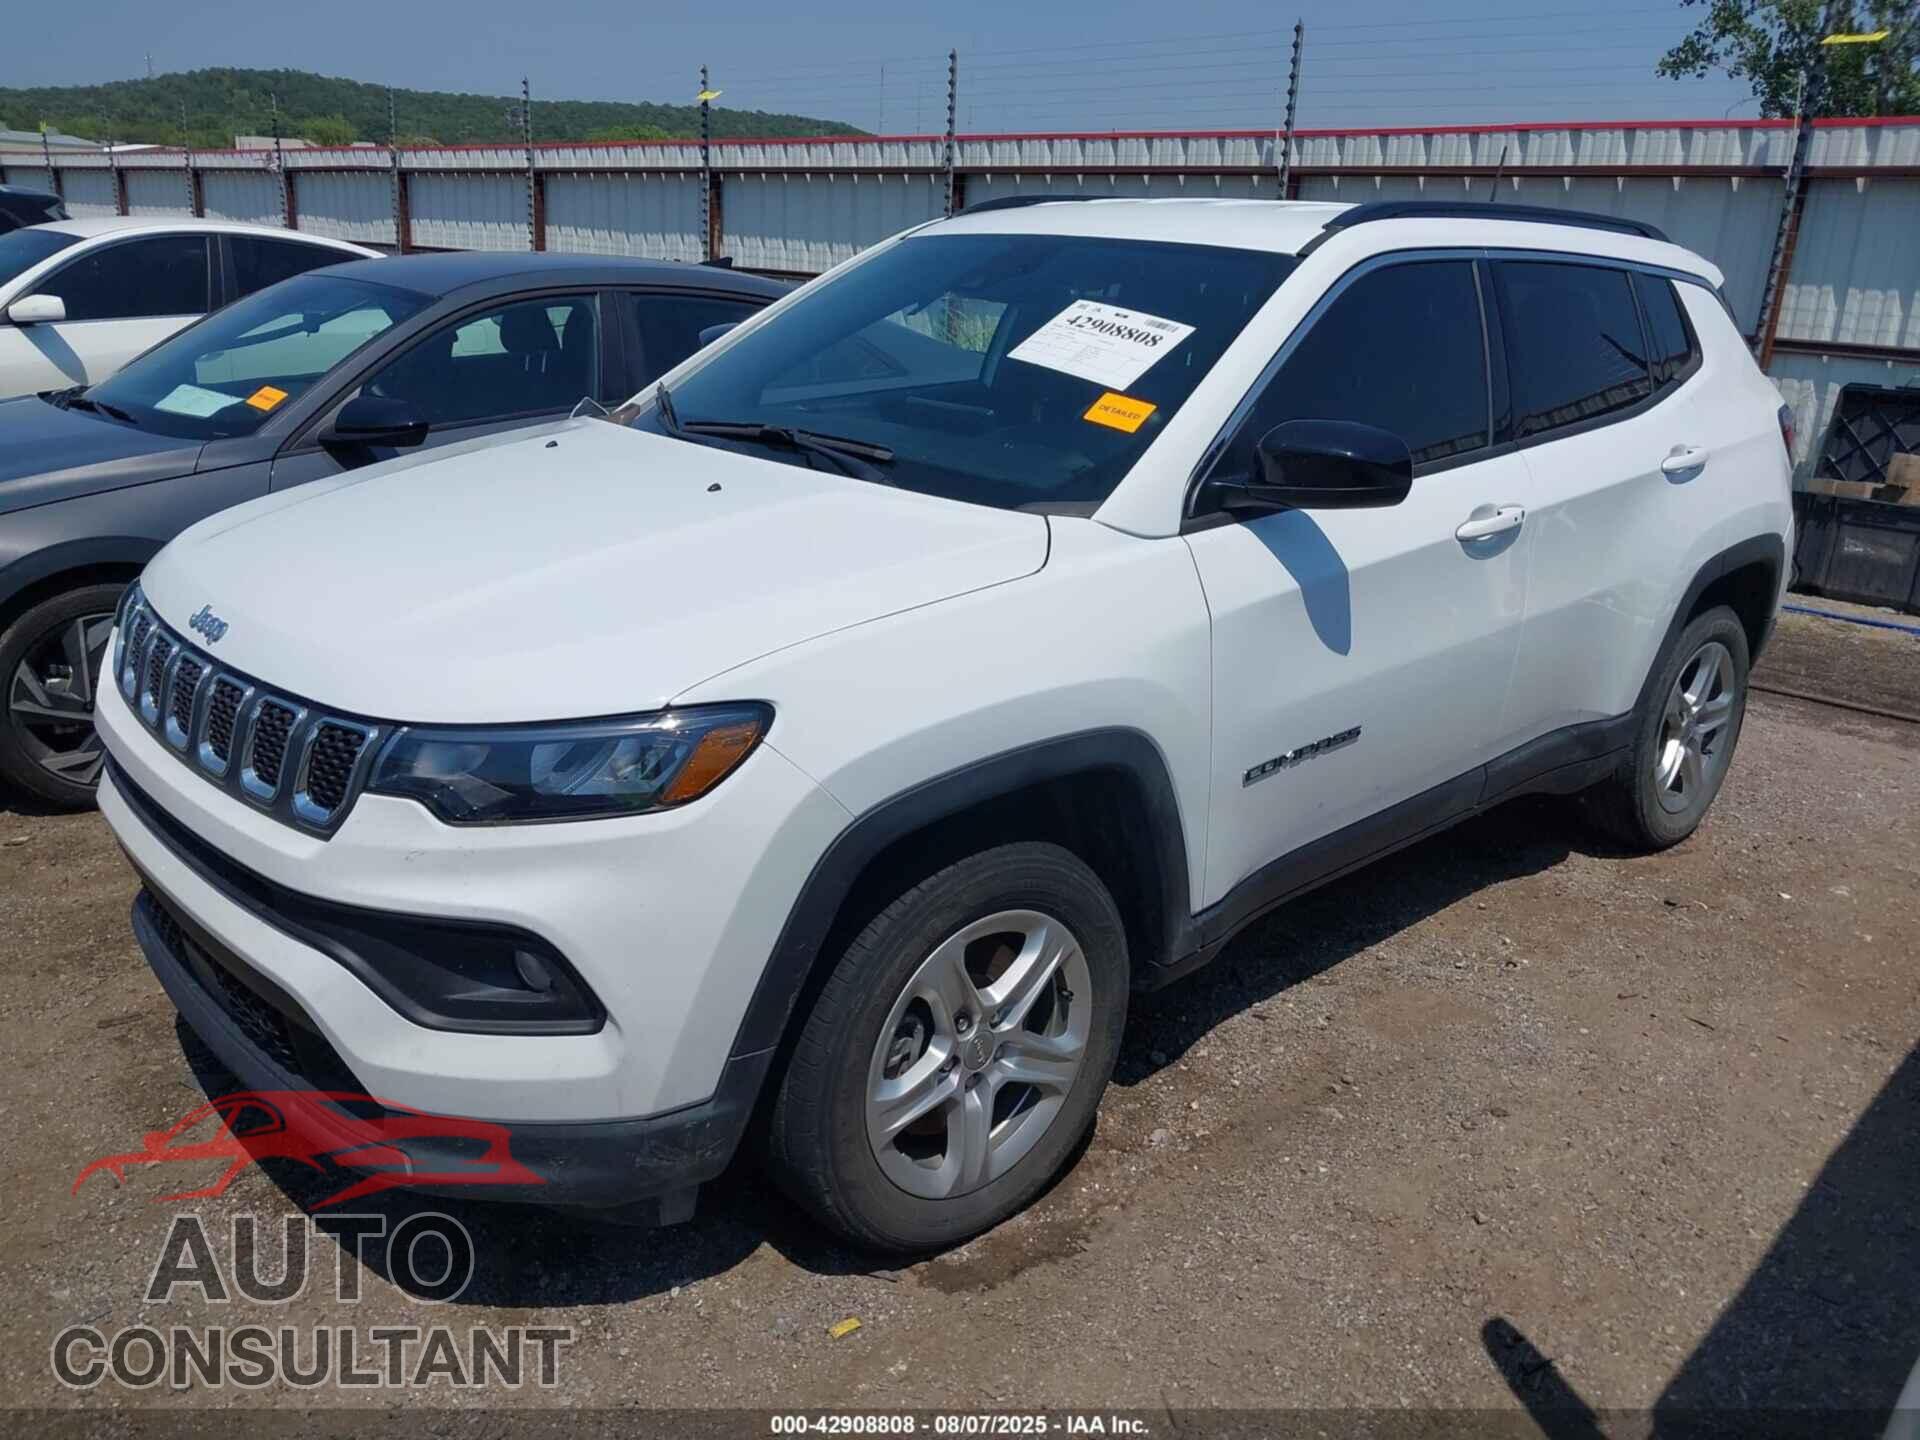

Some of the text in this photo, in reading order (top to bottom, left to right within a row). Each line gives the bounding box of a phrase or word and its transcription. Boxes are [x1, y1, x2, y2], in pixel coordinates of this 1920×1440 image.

[1066, 315, 1164, 347] 42908808
[1098, 404, 1141, 421] DETAILED
[189, 604, 229, 646] Jeep
[1243, 726, 1361, 784] COMPASS
